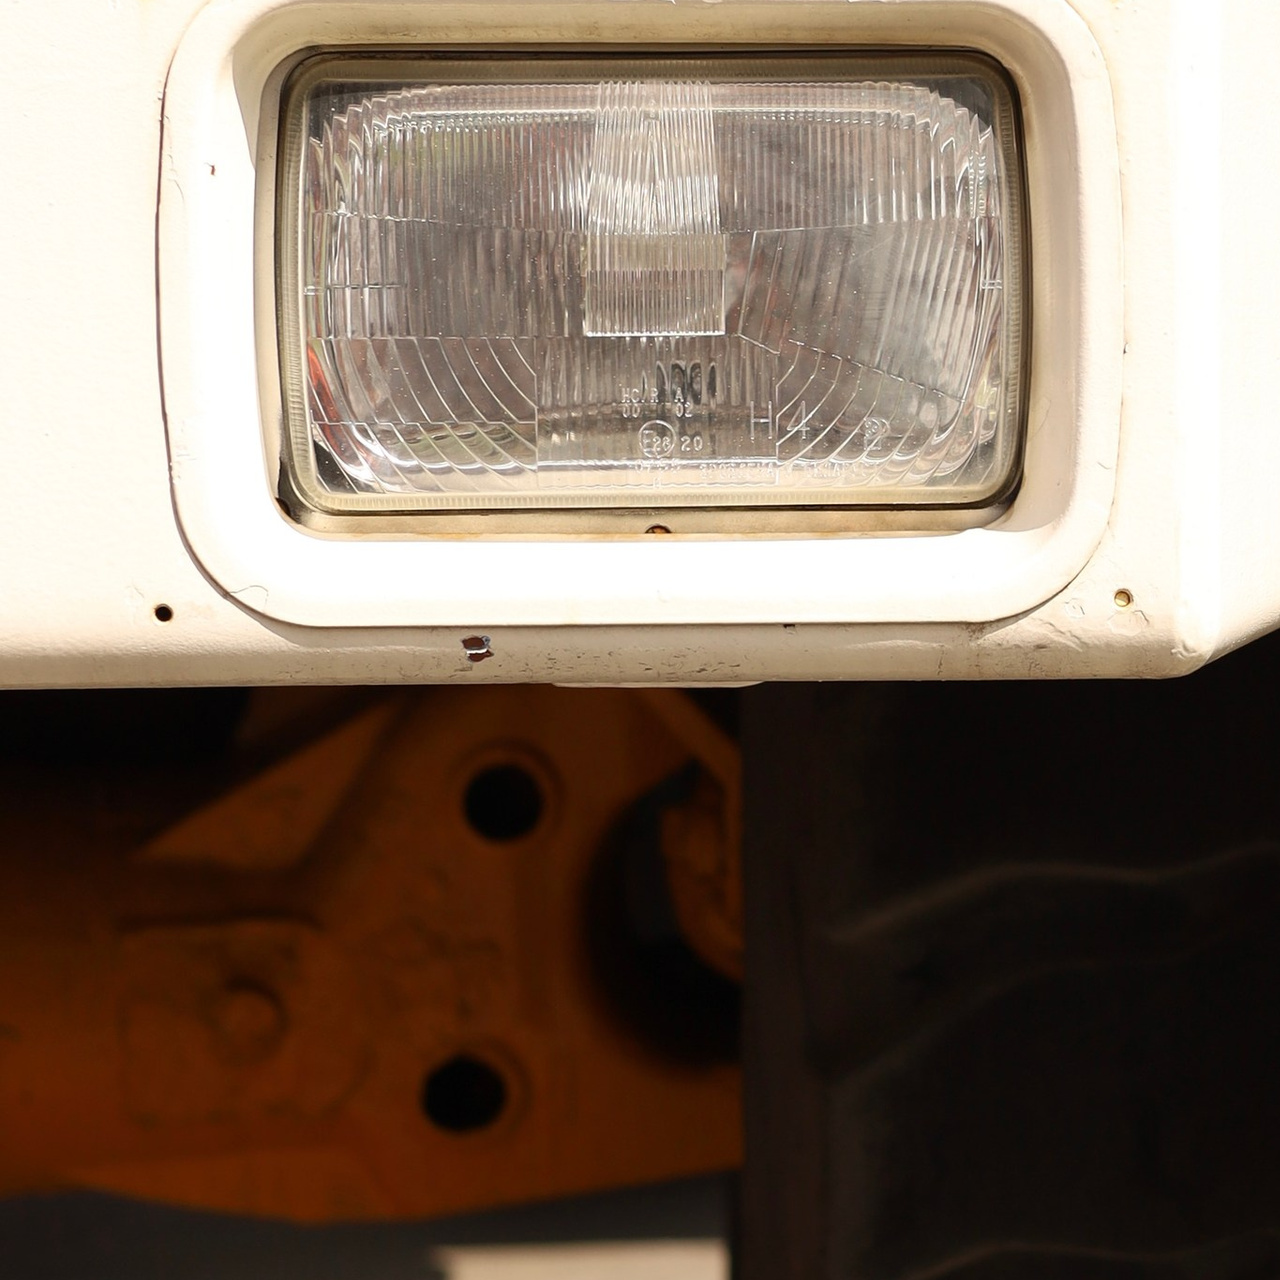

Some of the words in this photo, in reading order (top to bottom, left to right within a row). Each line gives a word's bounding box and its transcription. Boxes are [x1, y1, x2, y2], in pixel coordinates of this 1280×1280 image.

[674, 387, 684, 402] A
[675, 401, 693, 418] 02
[680, 435, 704, 452] 20
